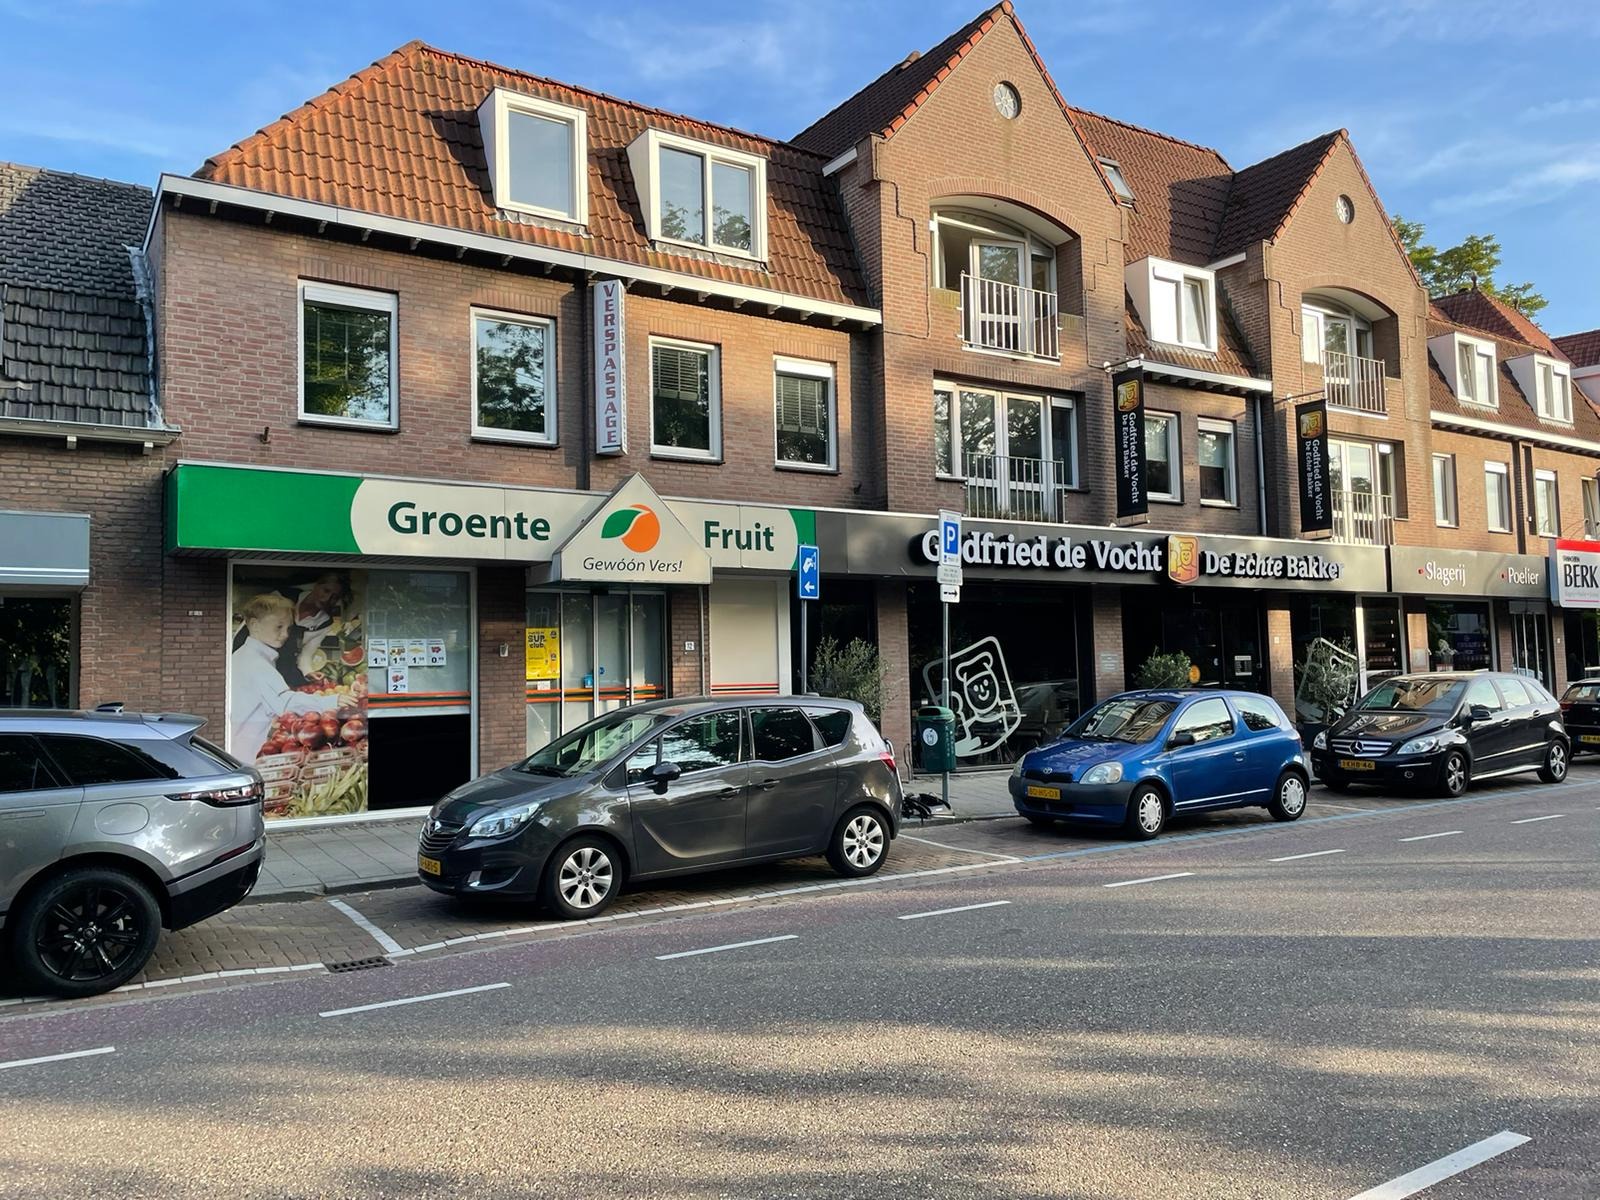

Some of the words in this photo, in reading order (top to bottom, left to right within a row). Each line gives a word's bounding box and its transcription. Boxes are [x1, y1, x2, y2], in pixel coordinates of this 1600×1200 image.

[603, 284, 617, 443] VERSPASSAGE
[1122, 414, 1128, 425] De
[1128, 412, 1138, 458] Godfried
[1305, 441, 1311, 450] De
[1130, 459, 1138, 472] de
[1312, 439, 1322, 481] Godfried
[1131, 472, 1139, 504] Vocht
[1314, 481, 1322, 492] de
[1315, 493, 1324, 521] Vocht
[388, 501, 551, 541] Groente
[704, 520, 775, 552] Fruit
[946, 525, 956, 550] P
[922, 529, 1050, 567] Gdfried
[1054, 537, 1086, 569] de
[1090, 539, 1163, 572] Vocht
[583, 556, 646, 572] Gewóón
[649, 559, 683, 573] Vers!
[1205, 550, 1232, 575] De
[1234, 552, 1283, 577] Echte
[1287, 554, 1345, 579] Bakker
[1425, 561, 1466, 587] Slagerij
[1507, 567, 1539, 586] Poelier
[1563, 563, 1599, 588] BERK
